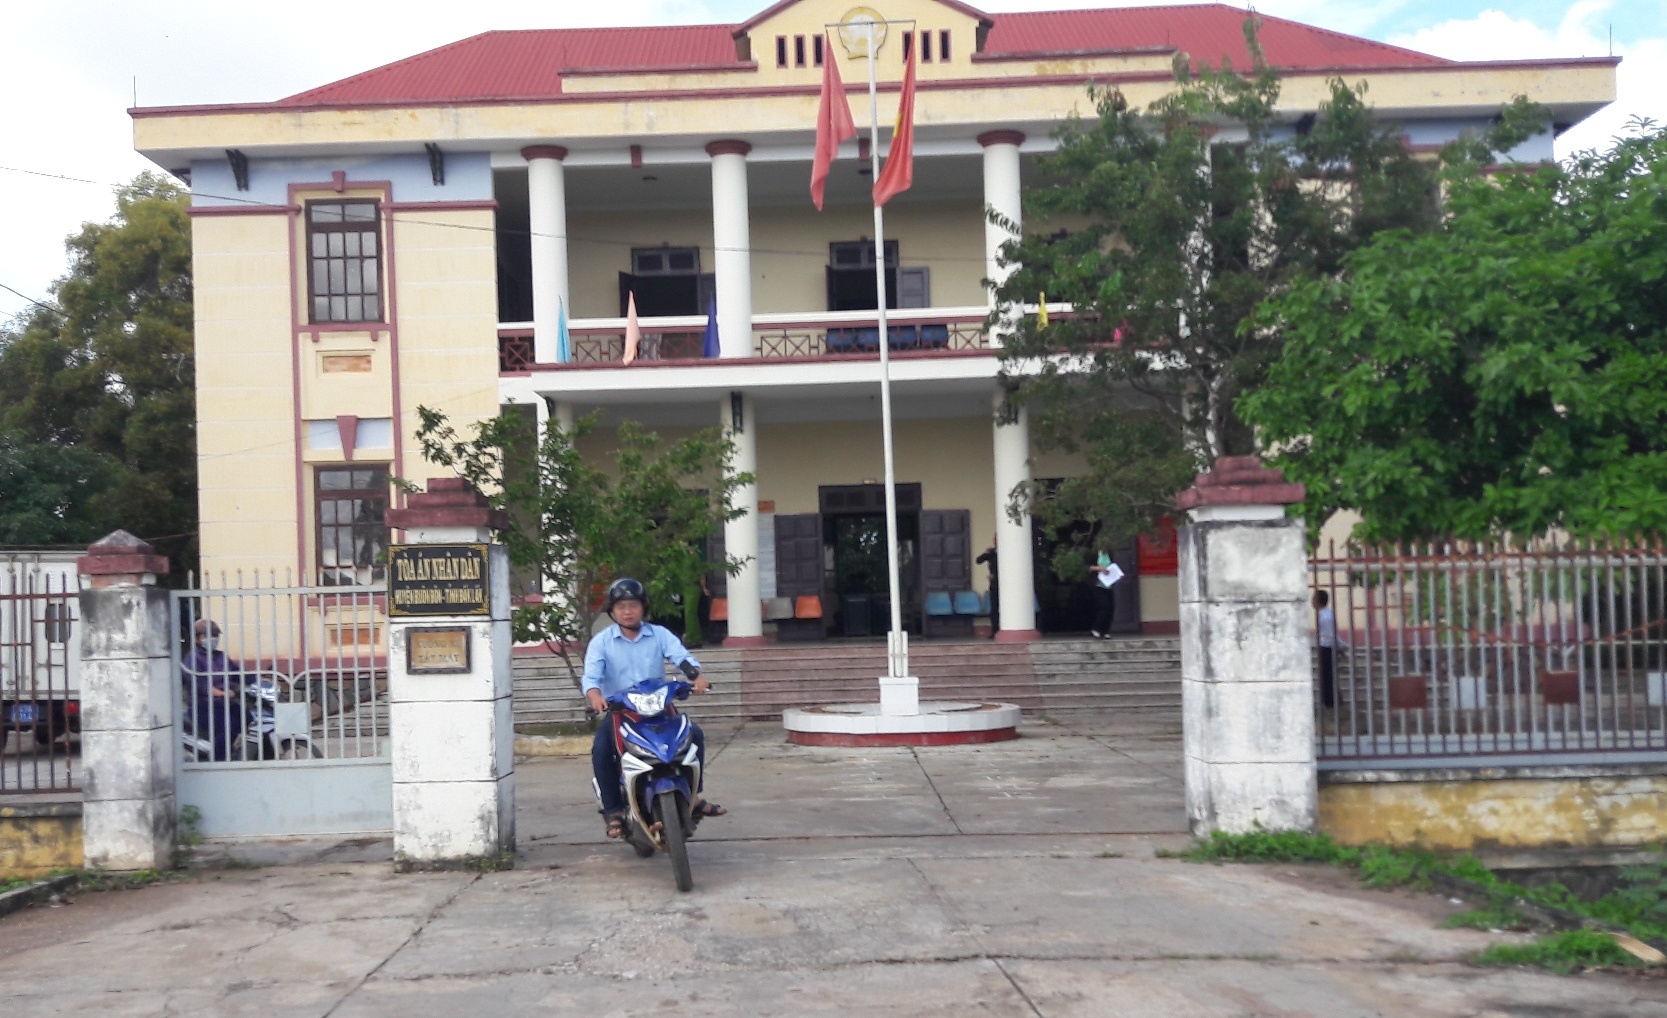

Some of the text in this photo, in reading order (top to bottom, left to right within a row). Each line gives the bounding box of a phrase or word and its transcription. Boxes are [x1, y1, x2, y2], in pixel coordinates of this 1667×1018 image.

[397, 551, 480, 581] TÒA ÁN NHÂN DÂN
